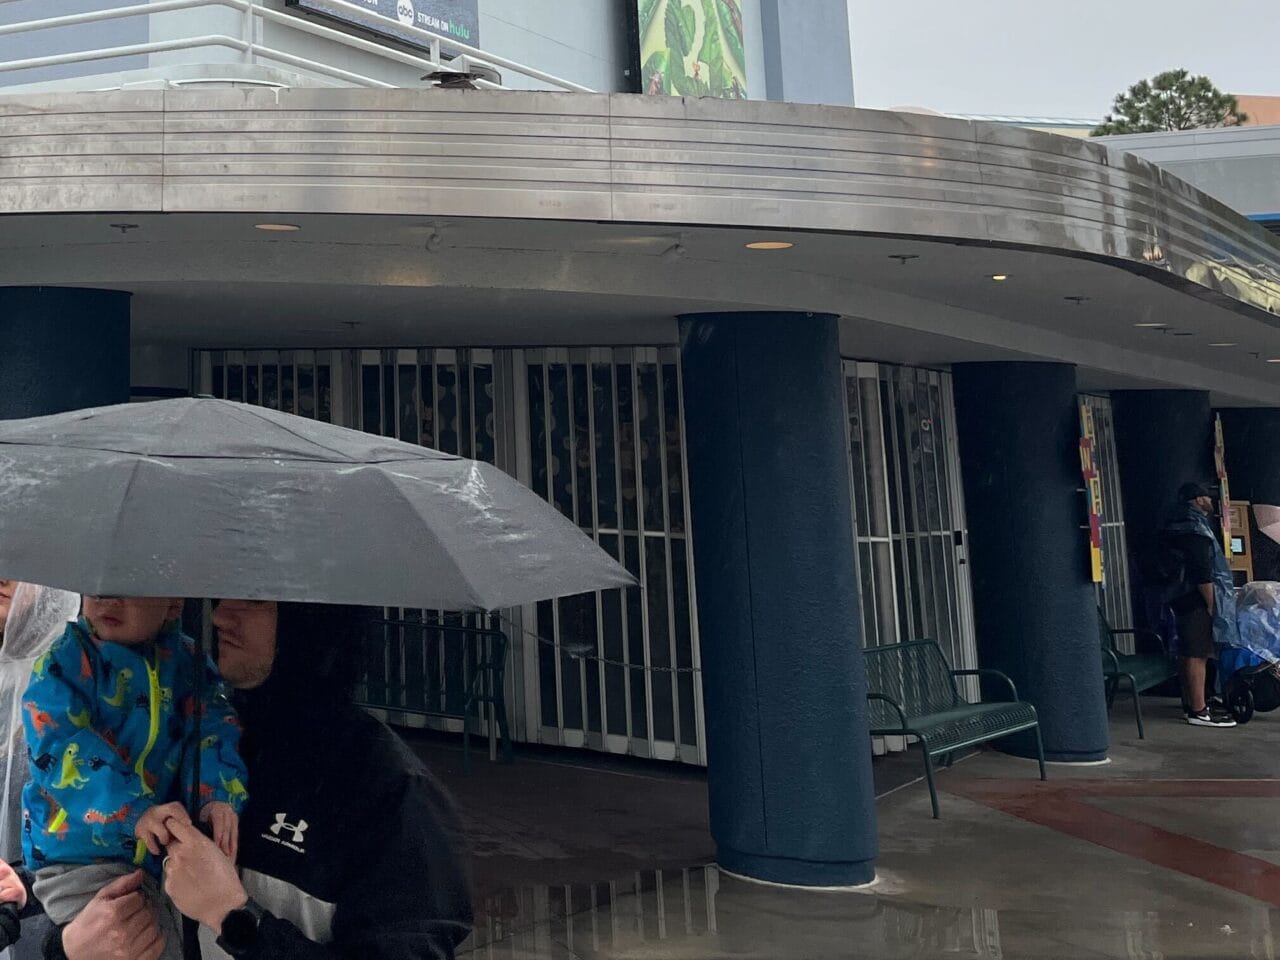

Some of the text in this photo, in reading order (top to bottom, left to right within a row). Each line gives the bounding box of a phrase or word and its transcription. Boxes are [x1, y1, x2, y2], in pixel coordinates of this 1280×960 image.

[417, 12, 470, 40] STREAM ON hulu
